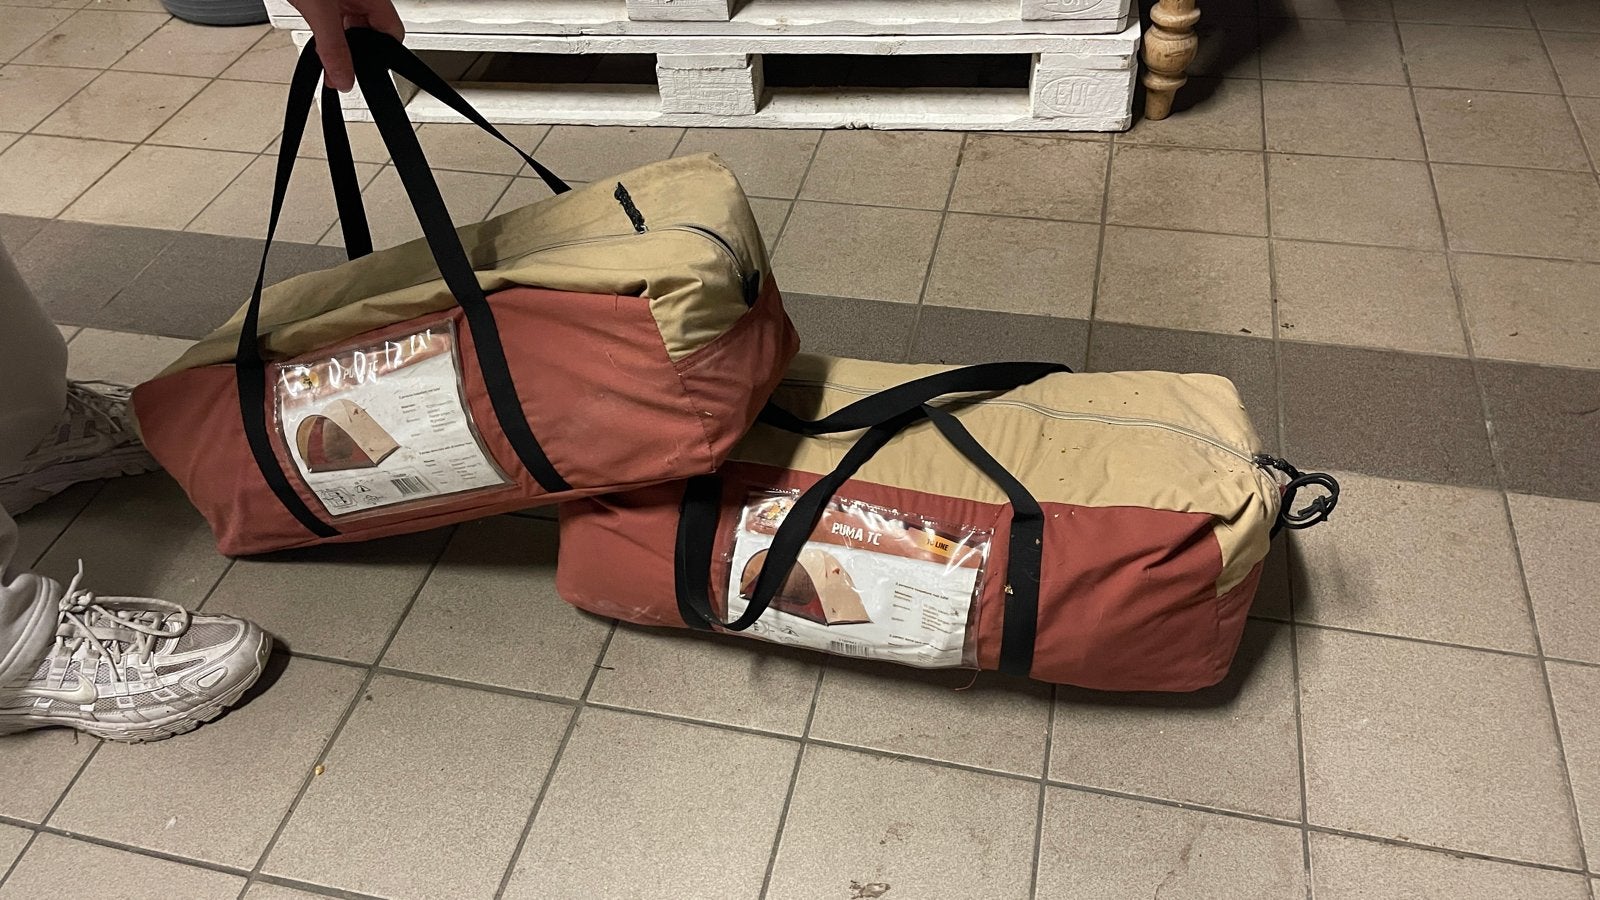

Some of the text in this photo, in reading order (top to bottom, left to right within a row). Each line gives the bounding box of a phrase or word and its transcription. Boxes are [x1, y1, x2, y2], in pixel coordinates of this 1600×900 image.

[831, 522, 882, 546] PUMA TC
[935, 542, 949, 551] LINE
